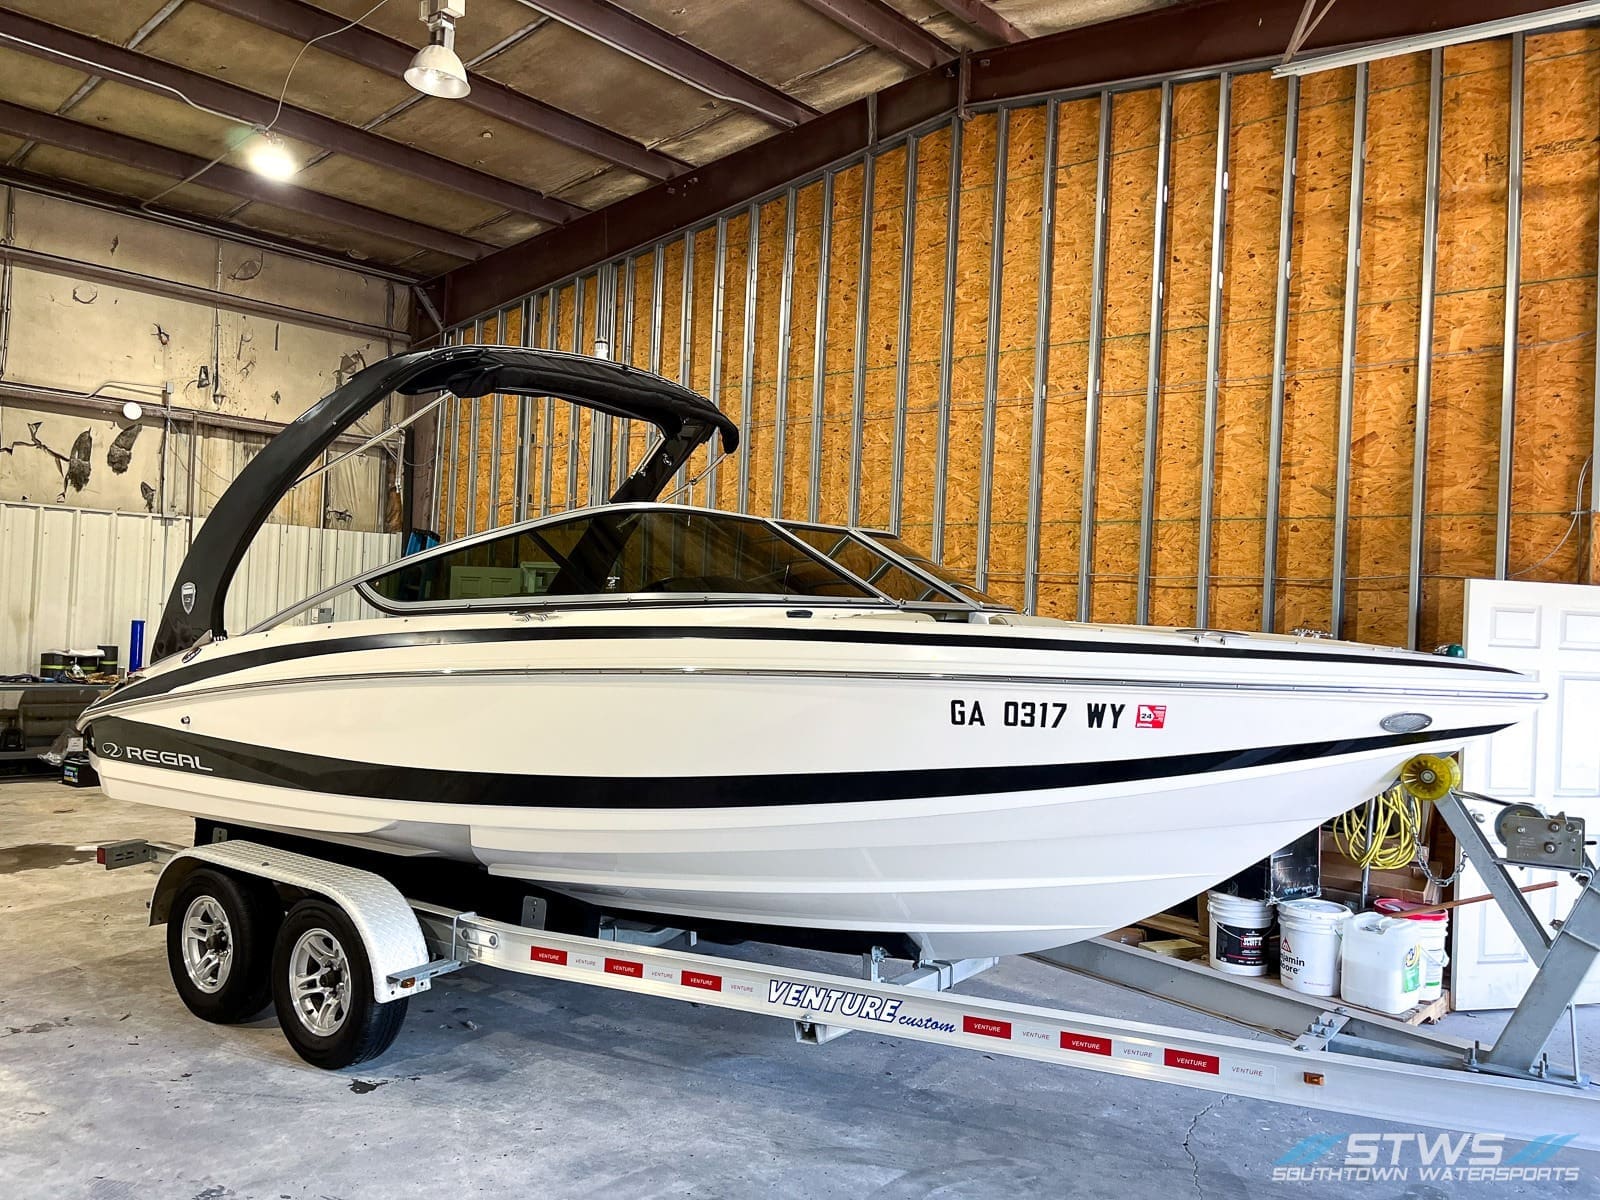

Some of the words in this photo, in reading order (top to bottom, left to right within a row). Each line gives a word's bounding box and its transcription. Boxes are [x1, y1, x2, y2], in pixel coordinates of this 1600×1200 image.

[950, 699, 986, 727] GA
[1003, 701, 1068, 729] 0317
[1087, 702, 1126, 729] WY
[126, 746, 213, 771] REGAL
[538, 952, 560, 961] VENTURE
[575, 958, 596, 967] VENTURE
[612, 964, 635, 974] VENTURE
[651, 970, 673, 980] VENTURE
[690, 977, 713, 987] VENTURE
[730, 983, 754, 993] VENTURE
[768, 979, 902, 1022] VENTURE
[898, 1014, 956, 1033] custom
[973, 1022, 1001, 1033] VENTURE
[1022, 1030, 1050, 1041] VENTURE
[1071, 1039, 1101, 1051] VENTURE
[1123, 1048, 1153, 1059] VENTURE
[1176, 1056, 1208, 1069] VENTURE
[1231, 1065, 1264, 1078] VENTURE
